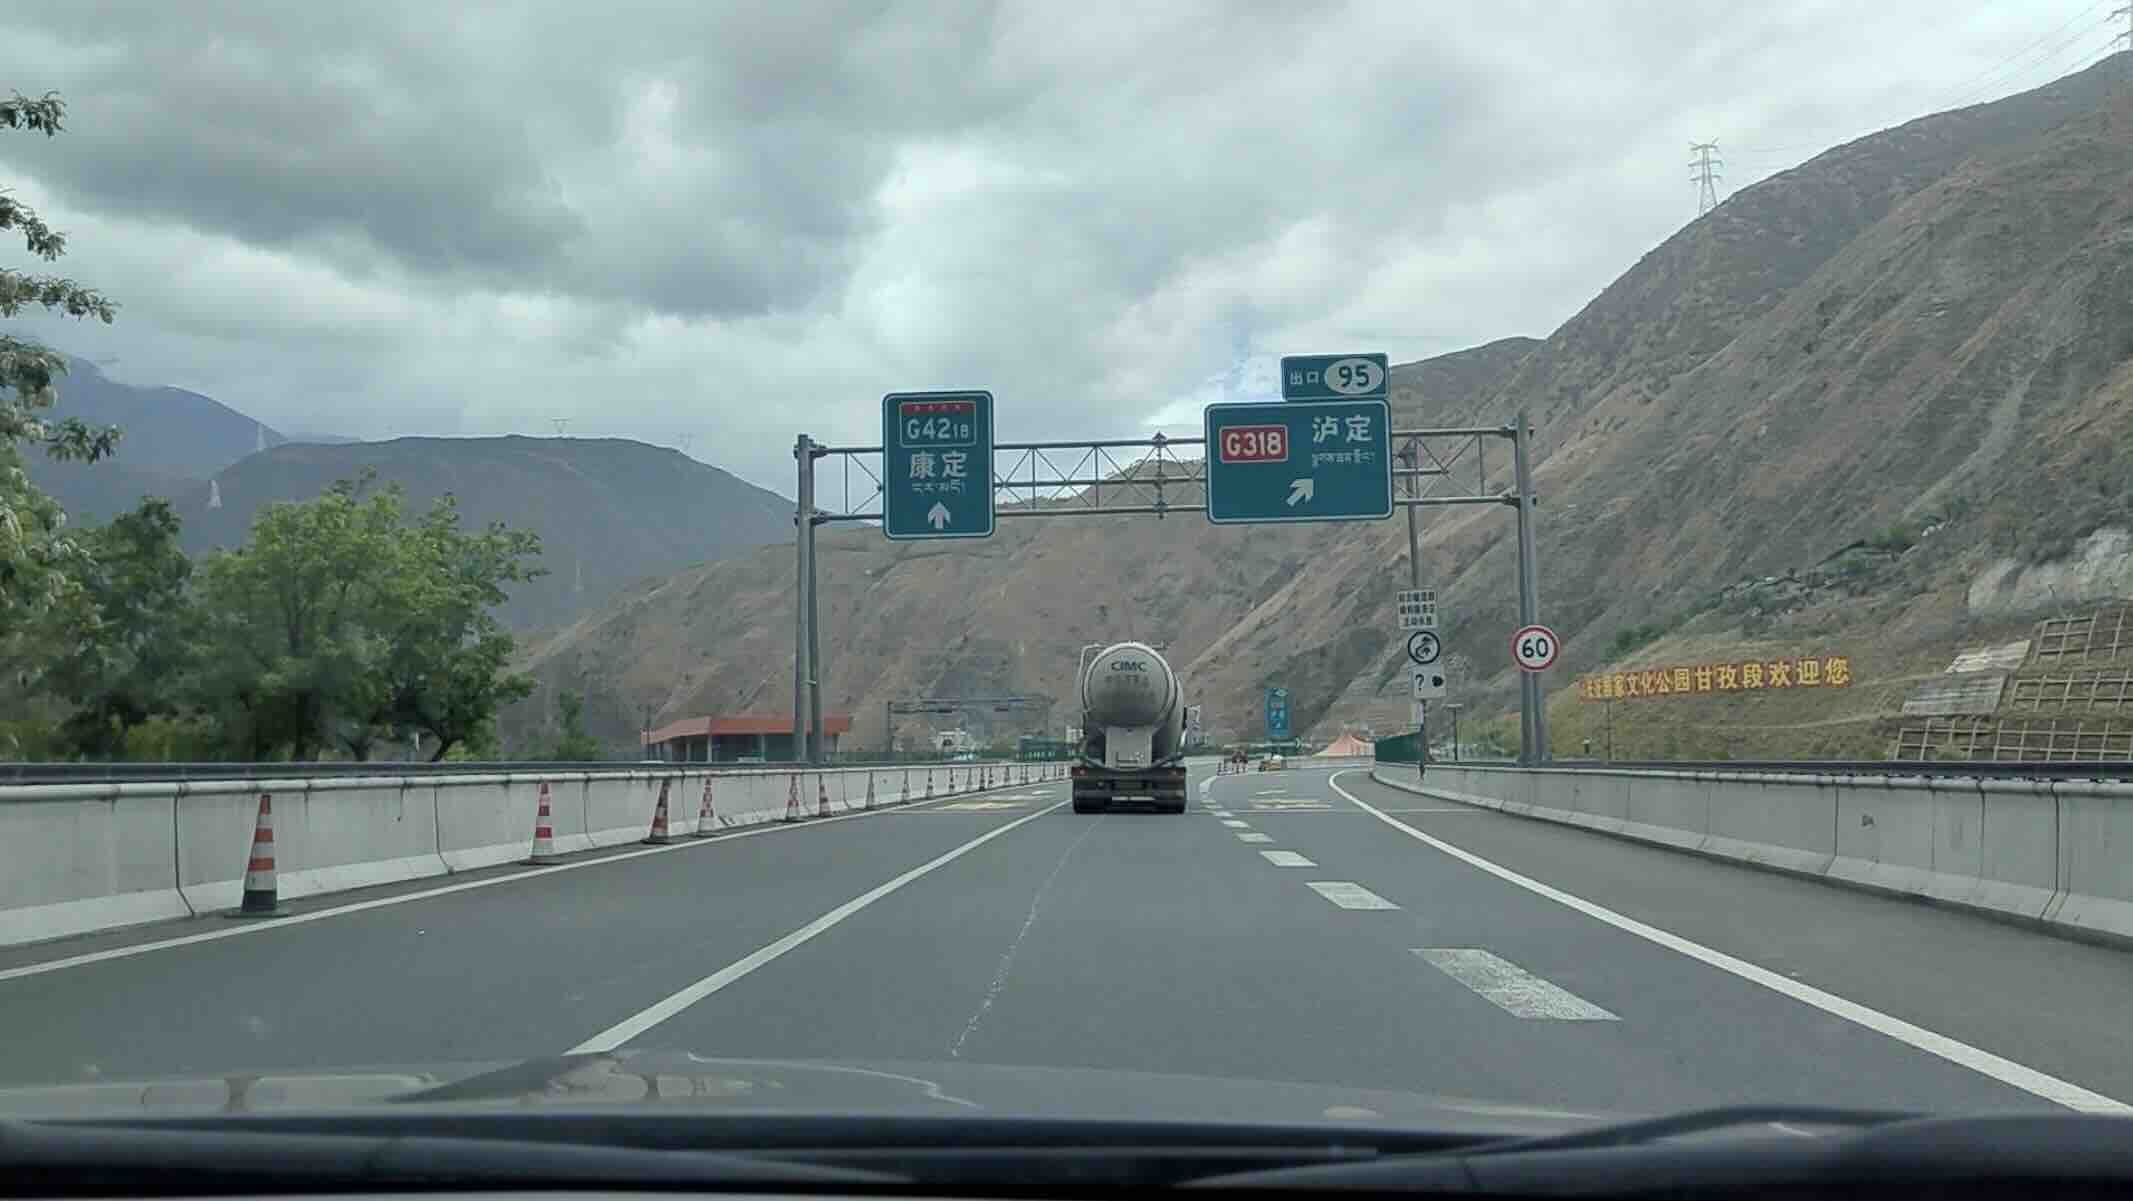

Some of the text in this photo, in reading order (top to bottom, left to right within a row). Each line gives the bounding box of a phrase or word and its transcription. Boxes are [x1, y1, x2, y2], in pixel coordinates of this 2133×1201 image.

[1289, 364, 1370, 388] 出口 95
[1312, 414, 1373, 443] 泸定
[1226, 431, 1282, 457] G318
[909, 451, 968, 479] 康定
[1521, 637, 1549, 658] 60
[1111, 660, 1148, 673] CIMC
